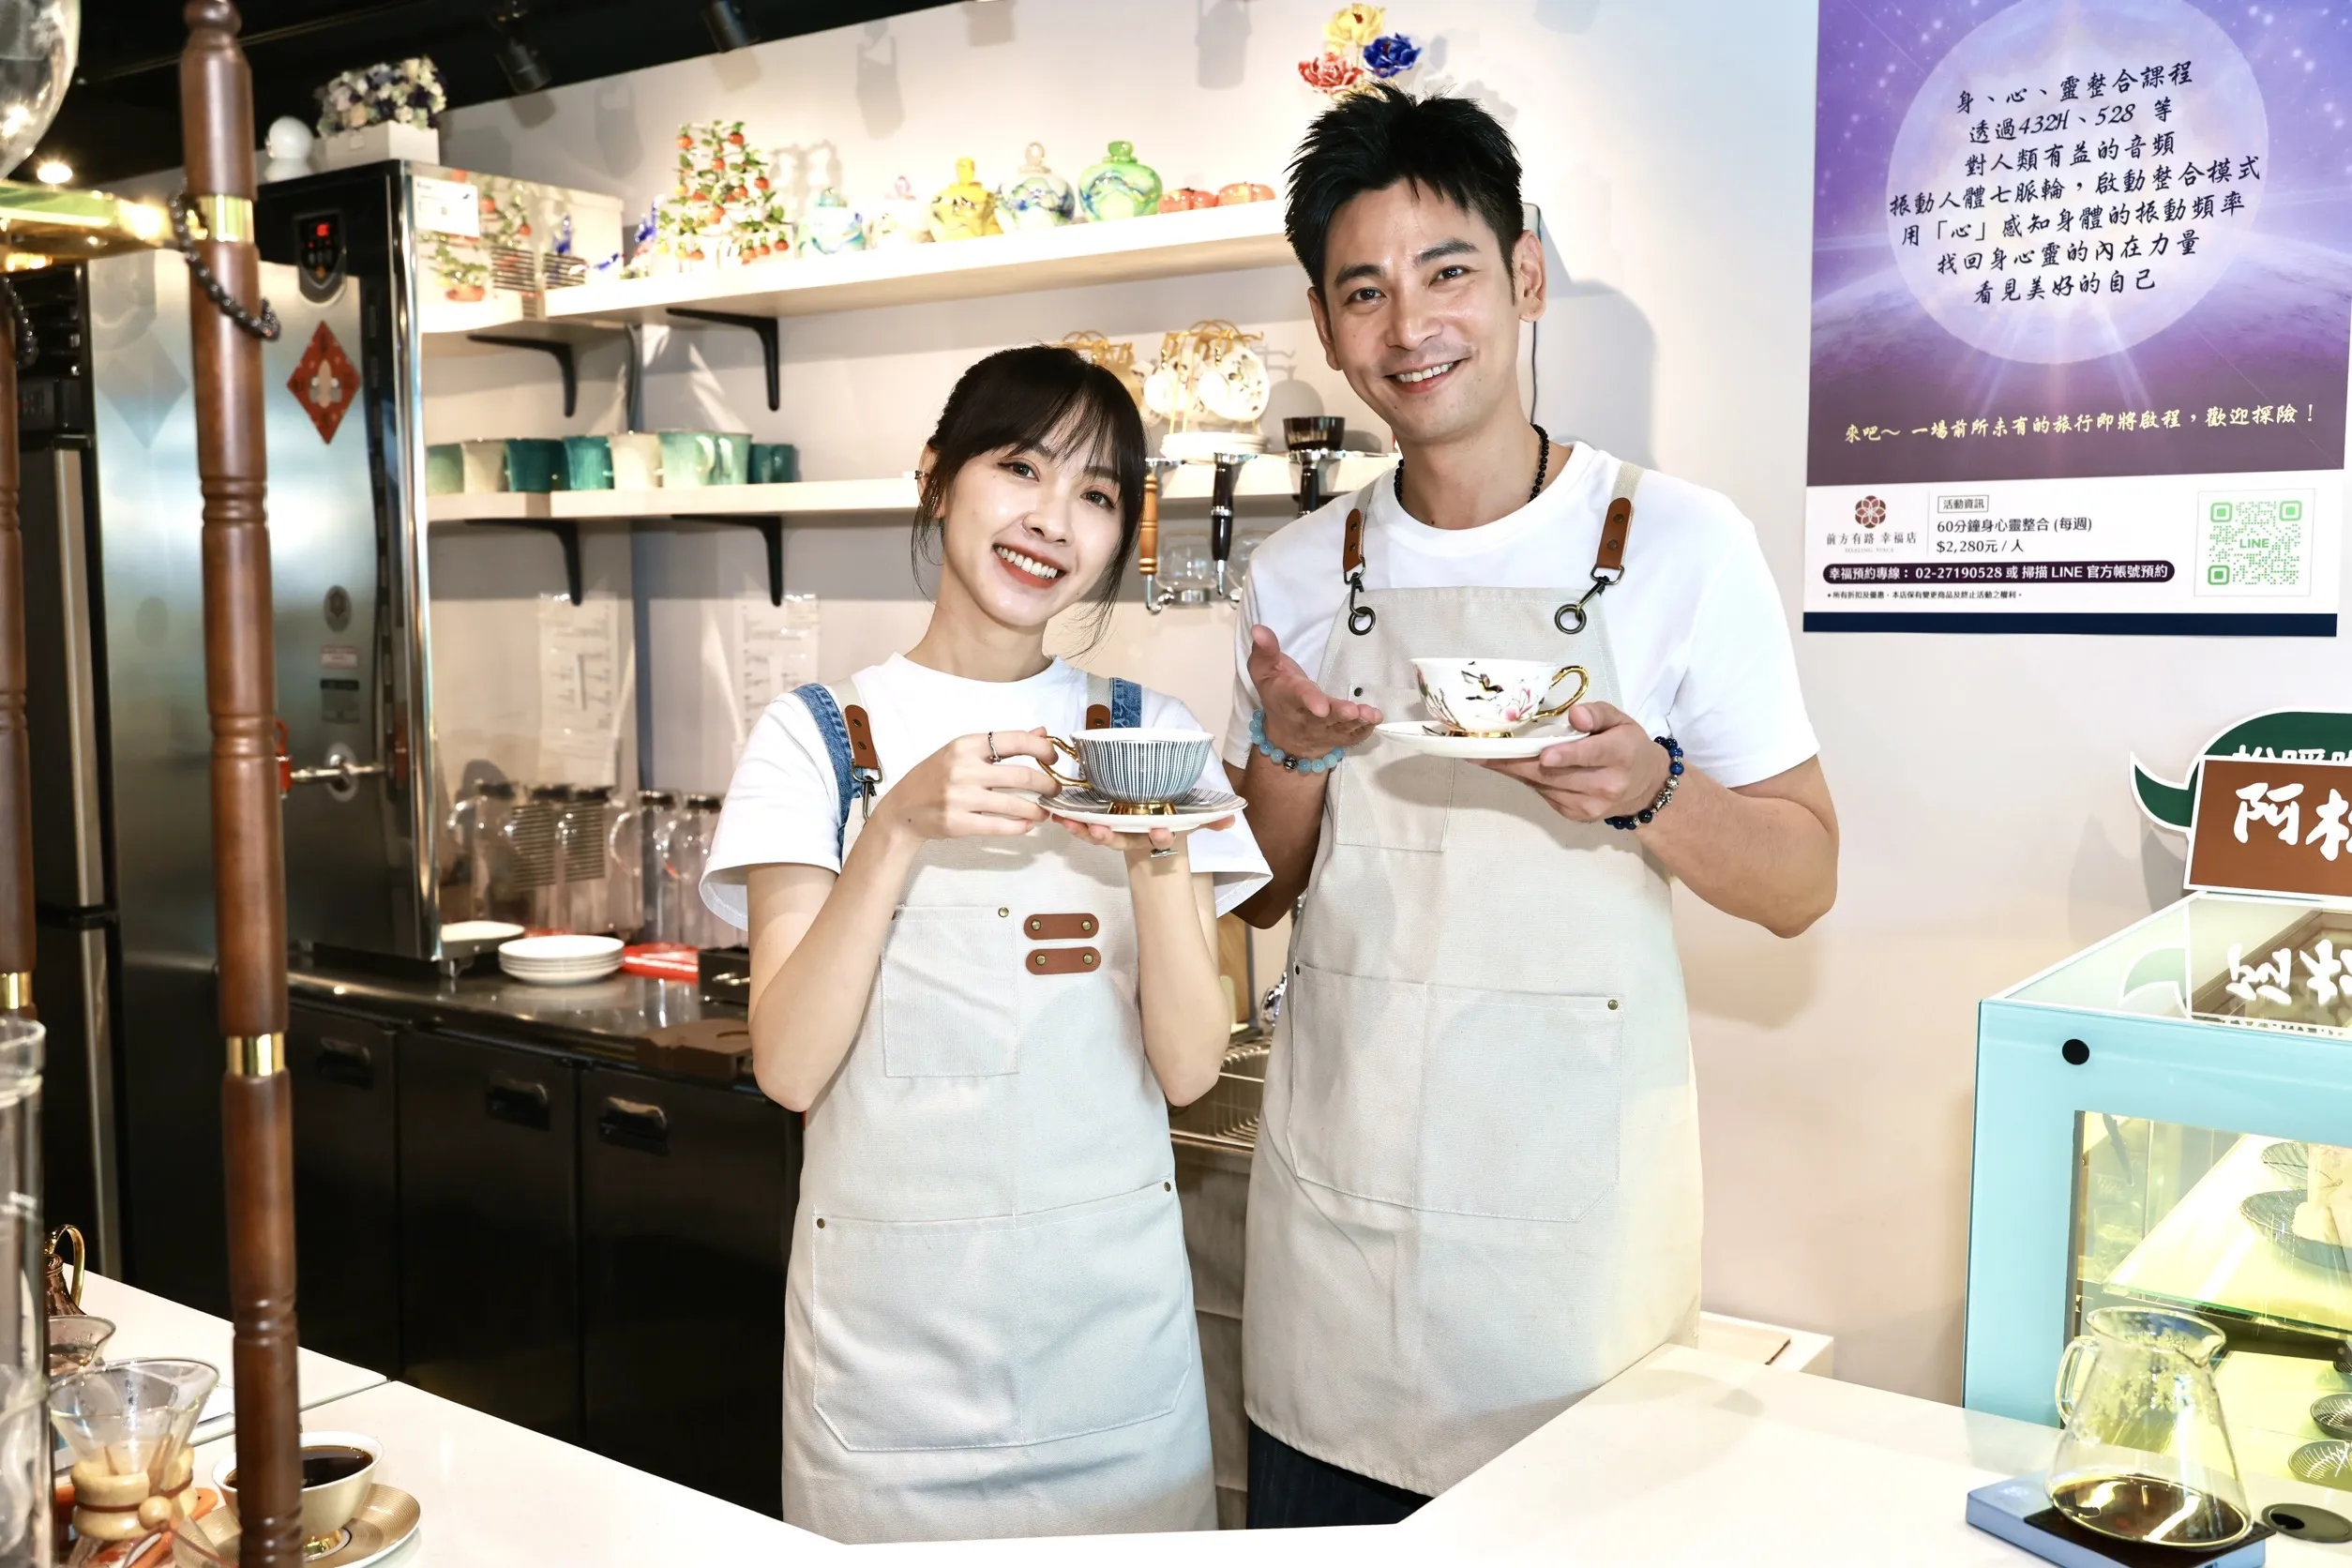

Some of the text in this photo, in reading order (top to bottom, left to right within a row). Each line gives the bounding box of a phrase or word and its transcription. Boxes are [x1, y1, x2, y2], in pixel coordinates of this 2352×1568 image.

[1956, 60, 2194, 114] 身、心、靈整合課程
[1969, 96, 2172, 144] 透過432H、528 等
[1965, 130, 2176, 177] 對人類有益的音頻
[1937, 229, 2200, 275] 找回身心靈的內在力量
[1974, 268, 2156, 305] 看見美好的自己
[1943, 499, 1984, 510] 活動資訊
[1937, 517, 2092, 534] 60分鐘身心靈整合 (每週)
[1826, 532, 1917, 546] 前方有路 幸福店
[1937, 540, 1998, 553] $2,280元
[2011, 539, 2024, 552] 人
[2239, 538, 2269, 549] LINE
[1915, 566, 2002, 580] 02-27190528
[2006, 565, 2018, 579] 或
[2022, 565, 2048, 579] 掃描
[2051, 566, 2083, 579] LINE
[2087, 565, 2168, 579] 官方帳號預約
